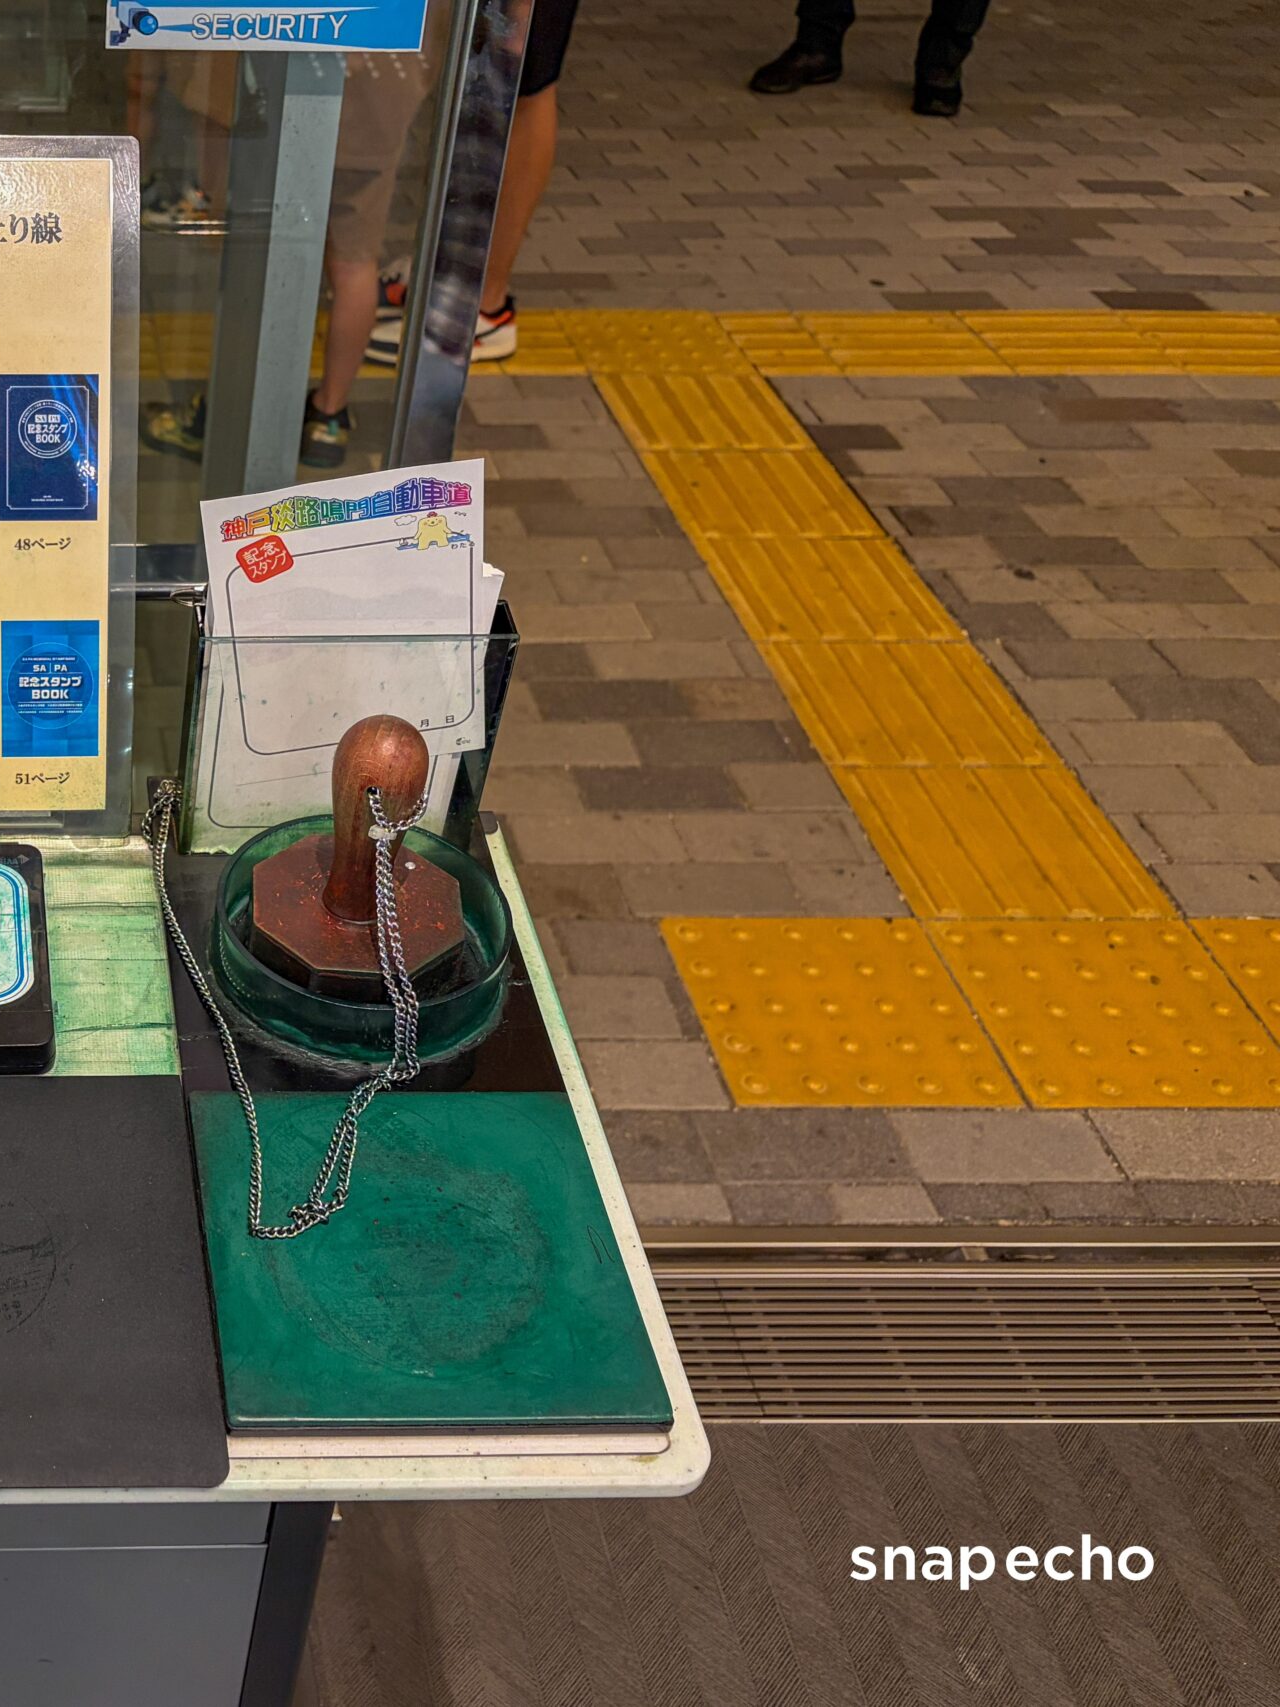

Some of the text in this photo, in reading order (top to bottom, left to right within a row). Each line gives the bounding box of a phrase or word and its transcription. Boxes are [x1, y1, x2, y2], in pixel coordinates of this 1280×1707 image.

[191, 13, 349, 39] SECURITY
[36, 434, 61, 443] BOOK
[221, 477, 472, 542] 神戸淡路鳴門自動車道
[14, 538, 71, 551] 48ページ
[244, 541, 280, 565] 記念
[248, 553, 288, 579] スタンプ
[18, 676, 82, 687] 記念スタンプ
[32, 689, 69, 699] BOOK
[445, 714, 454, 724] 日
[16, 771, 70, 785] 51ページ
